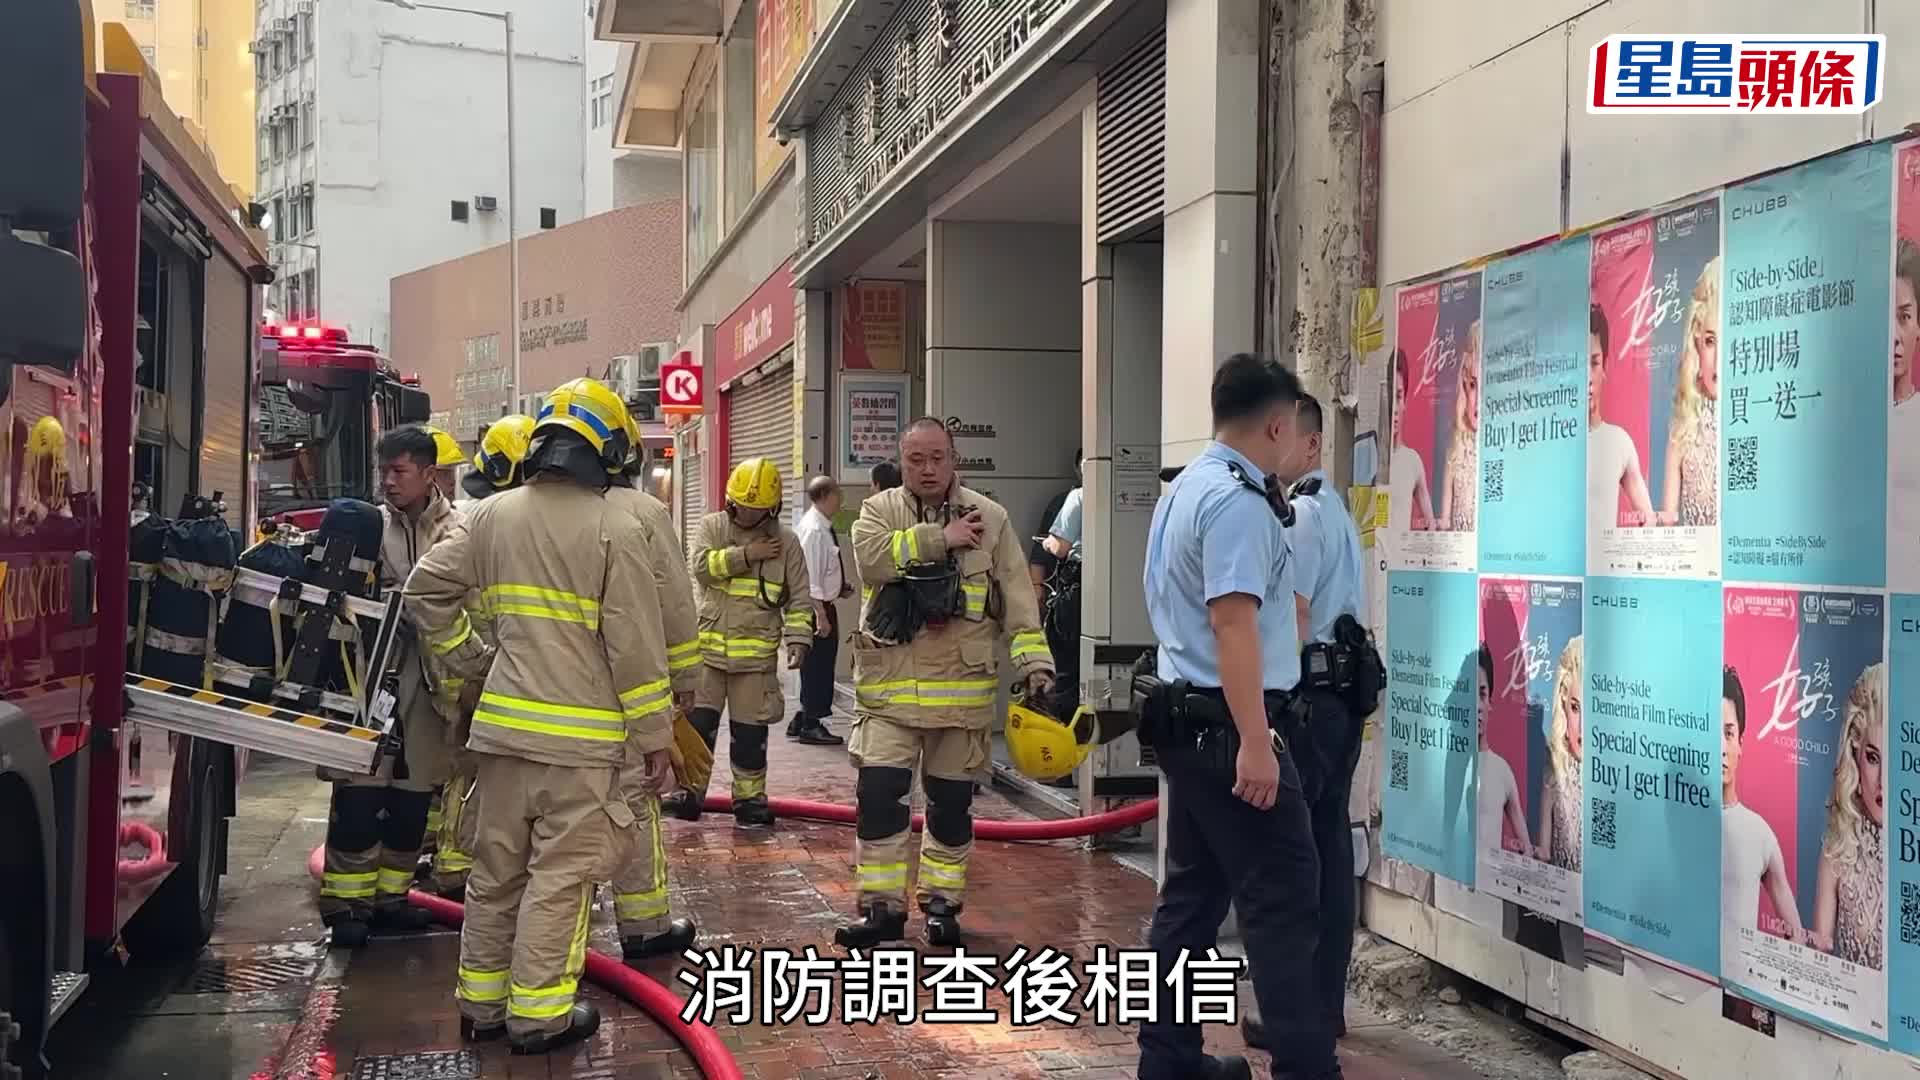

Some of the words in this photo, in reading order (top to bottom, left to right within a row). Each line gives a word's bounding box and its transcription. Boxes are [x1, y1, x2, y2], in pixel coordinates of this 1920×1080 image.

[959, 5, 1041, 101] CENTRE
[1732, 195, 1788, 220] CHUBB
[1488, 272, 1524, 290] CHUBB
[1729, 279, 1856, 326] 認知障礙症電影節
[1729, 329, 1800, 378] 特別場
[675, 376, 695, 398] K
[1485, 391, 1520, 419] Special
[1523, 384, 1578, 410] Screening
[1729, 380, 1822, 425] 買一送一
[1485, 423, 1508, 450] Buy
[1518, 421, 1538, 449] get
[1550, 412, 1577, 440] free
[1392, 585, 1424, 597] CHUBB
[1592, 595, 1639, 609] CHUBB
[1592, 674, 1652, 699] Side-by-side
[1391, 691, 1421, 714] Special
[1424, 697, 1470, 729] Screening
[1592, 696, 1640, 721] Dementia
[1642, 704, 1666, 725] Film
[1668, 708, 1710, 732] Festival
[1391, 716, 1415, 746] Buy
[1420, 726, 1437, 750] get
[1446, 728, 1469, 753] free
[1592, 726, 1636, 754] Special
[1640, 735, 1711, 776] Screening
[1805, 740, 1830, 755] CHILD
[1592, 756, 1621, 794] Buy
[1634, 771, 1660, 800] get
[1675, 772, 1711, 809] free
